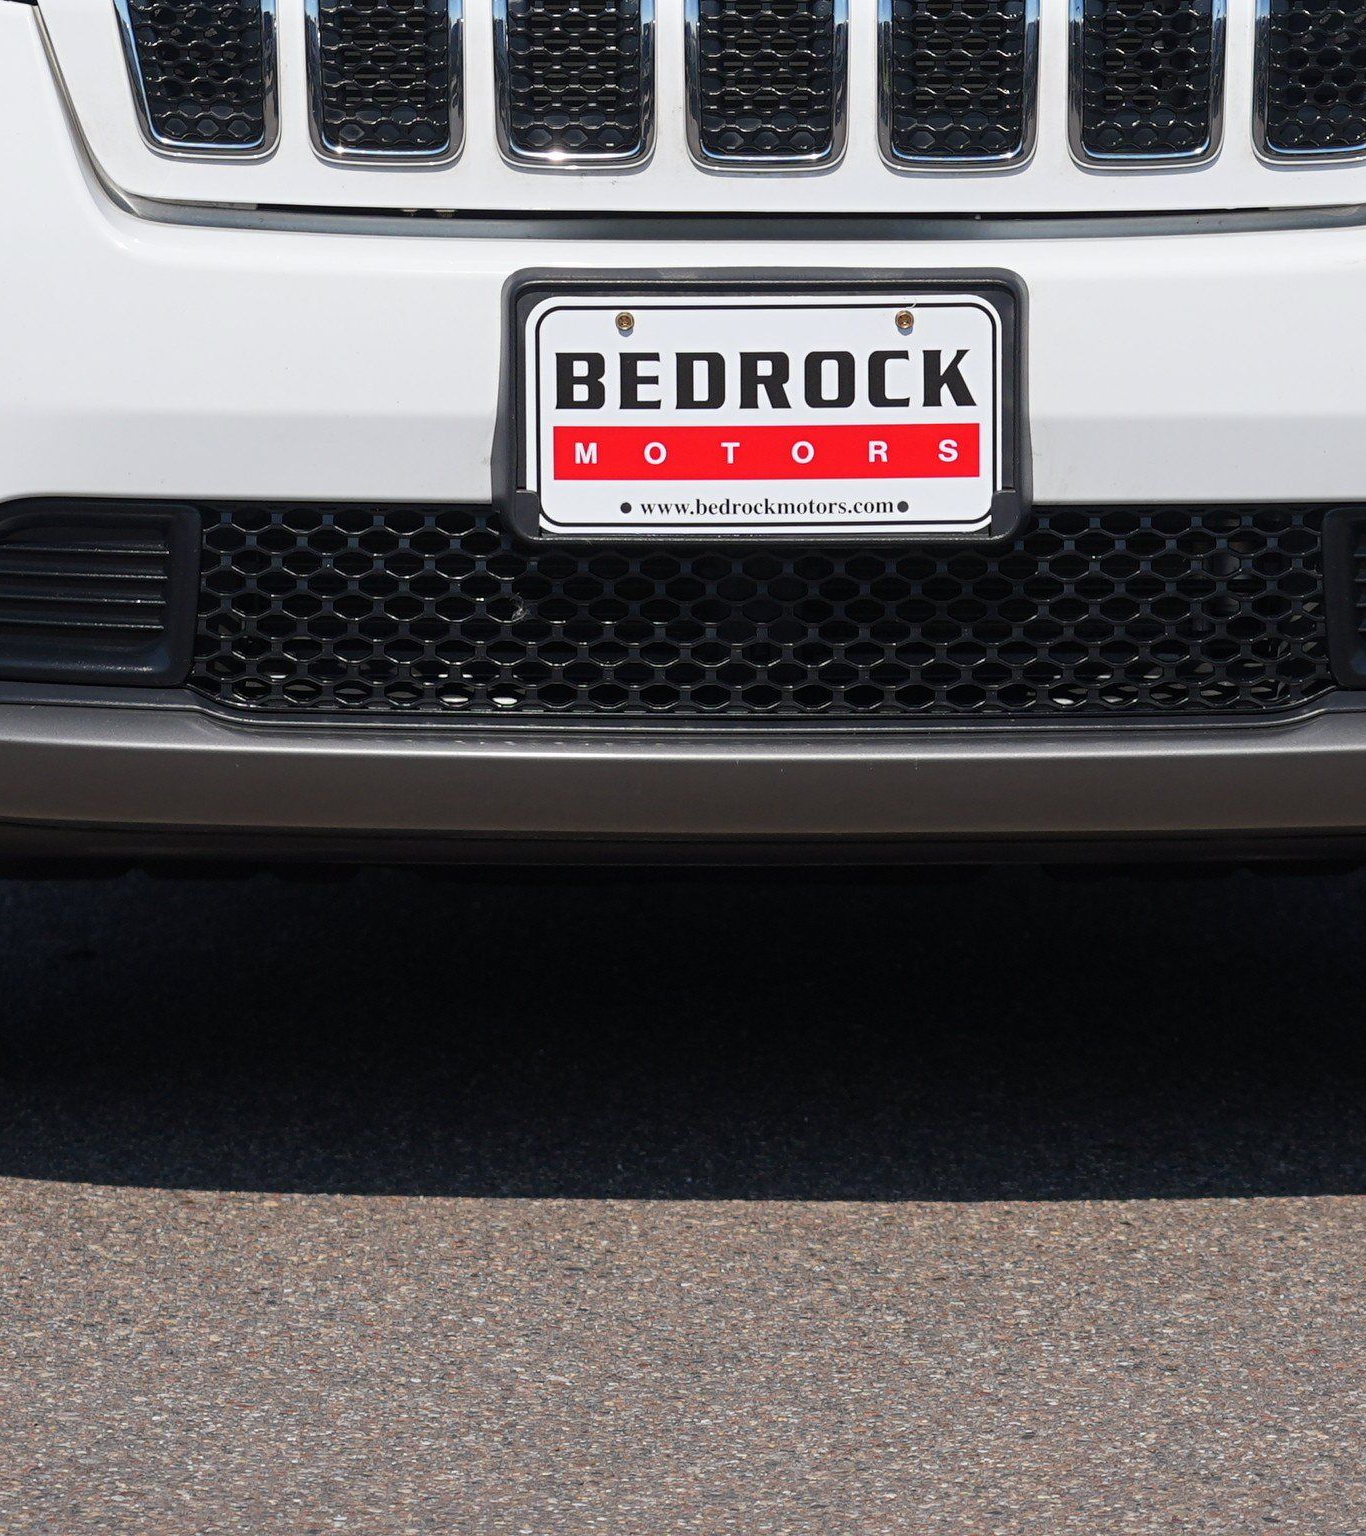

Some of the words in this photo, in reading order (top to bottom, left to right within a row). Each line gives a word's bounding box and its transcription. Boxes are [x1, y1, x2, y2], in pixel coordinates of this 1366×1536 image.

[555, 349, 977, 410] BEDROCK
[574, 438, 959, 465] MOTORS
[640, 496, 894, 517] www.bedrockmotors.com
